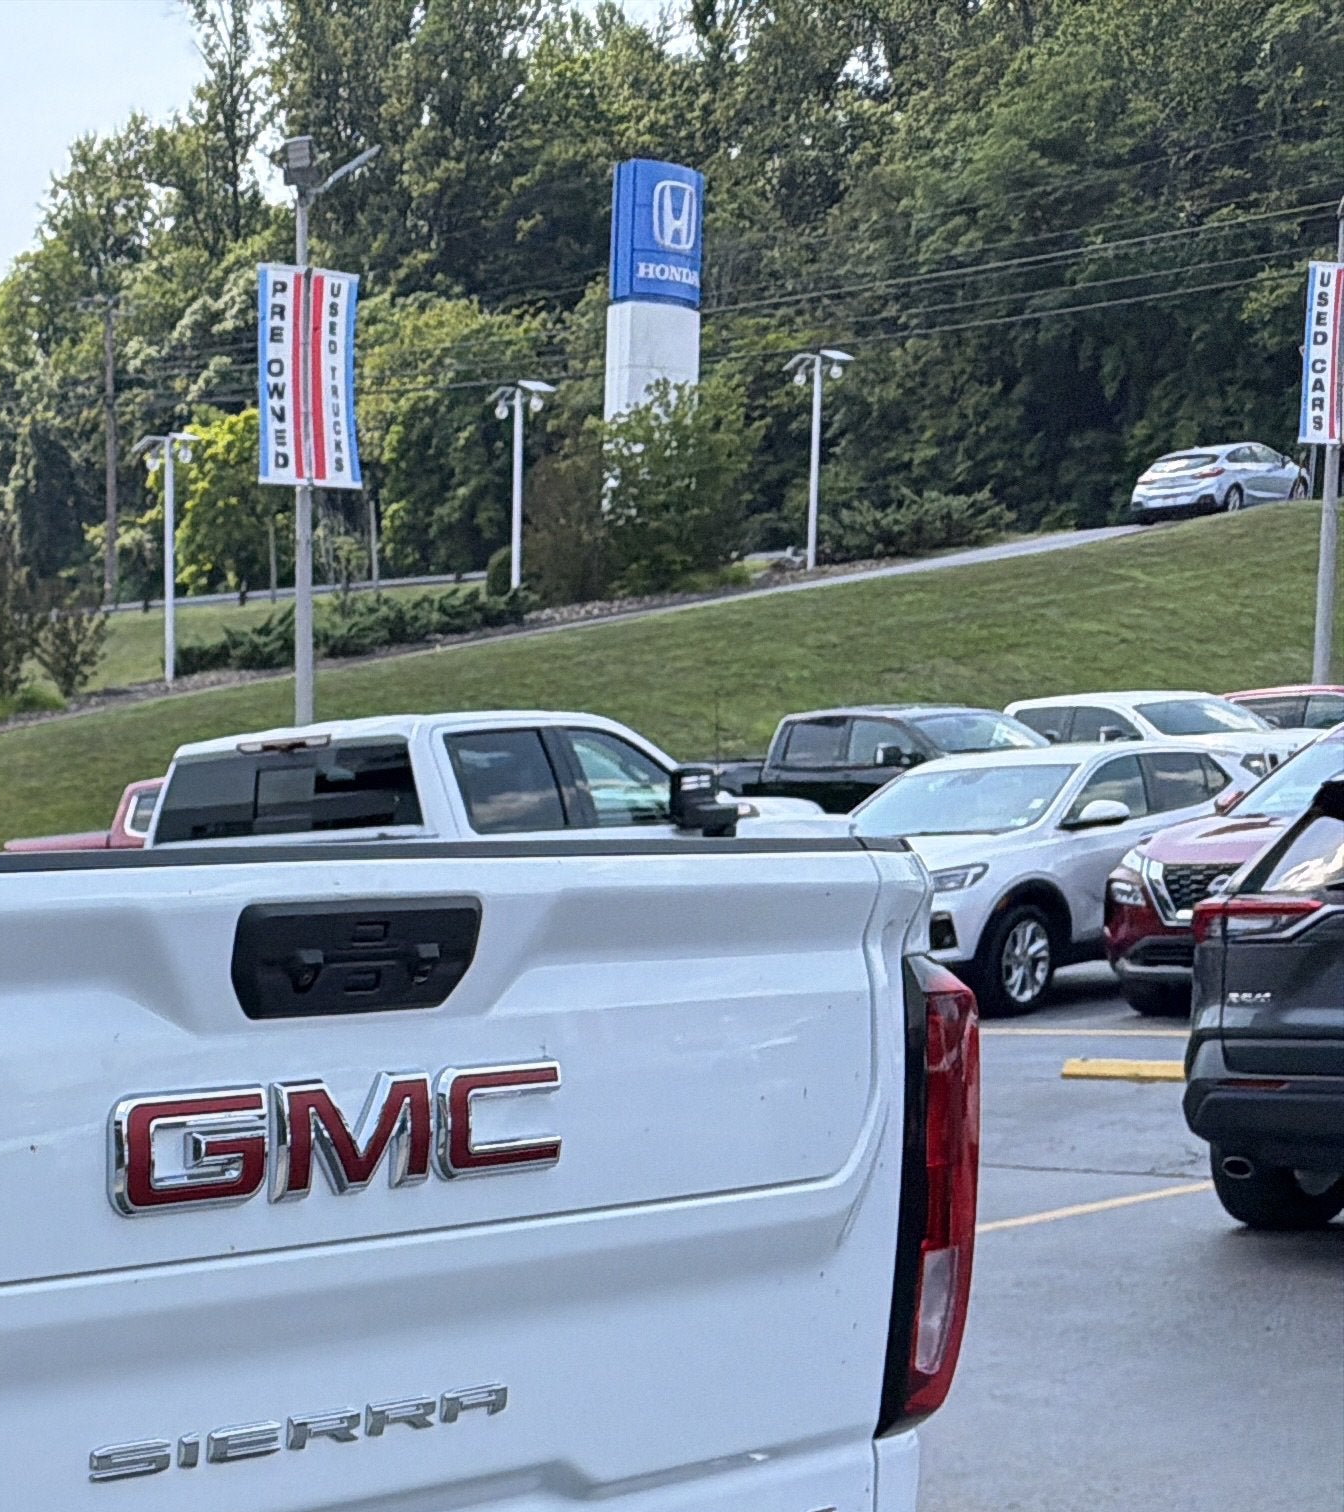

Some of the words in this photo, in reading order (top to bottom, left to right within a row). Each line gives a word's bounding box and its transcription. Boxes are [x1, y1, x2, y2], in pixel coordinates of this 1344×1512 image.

[269, 280, 288, 344] PRE
[328, 282, 342, 355] USED
[1312, 271, 1332, 346] USED
[266, 358, 289, 469] OWNED
[330, 366, 345, 473] TRUCKS
[1311, 358, 1327, 431] CARS
[106, 1058, 562, 1217] GMC
[88, 1380, 509, 1483] SIERRA
